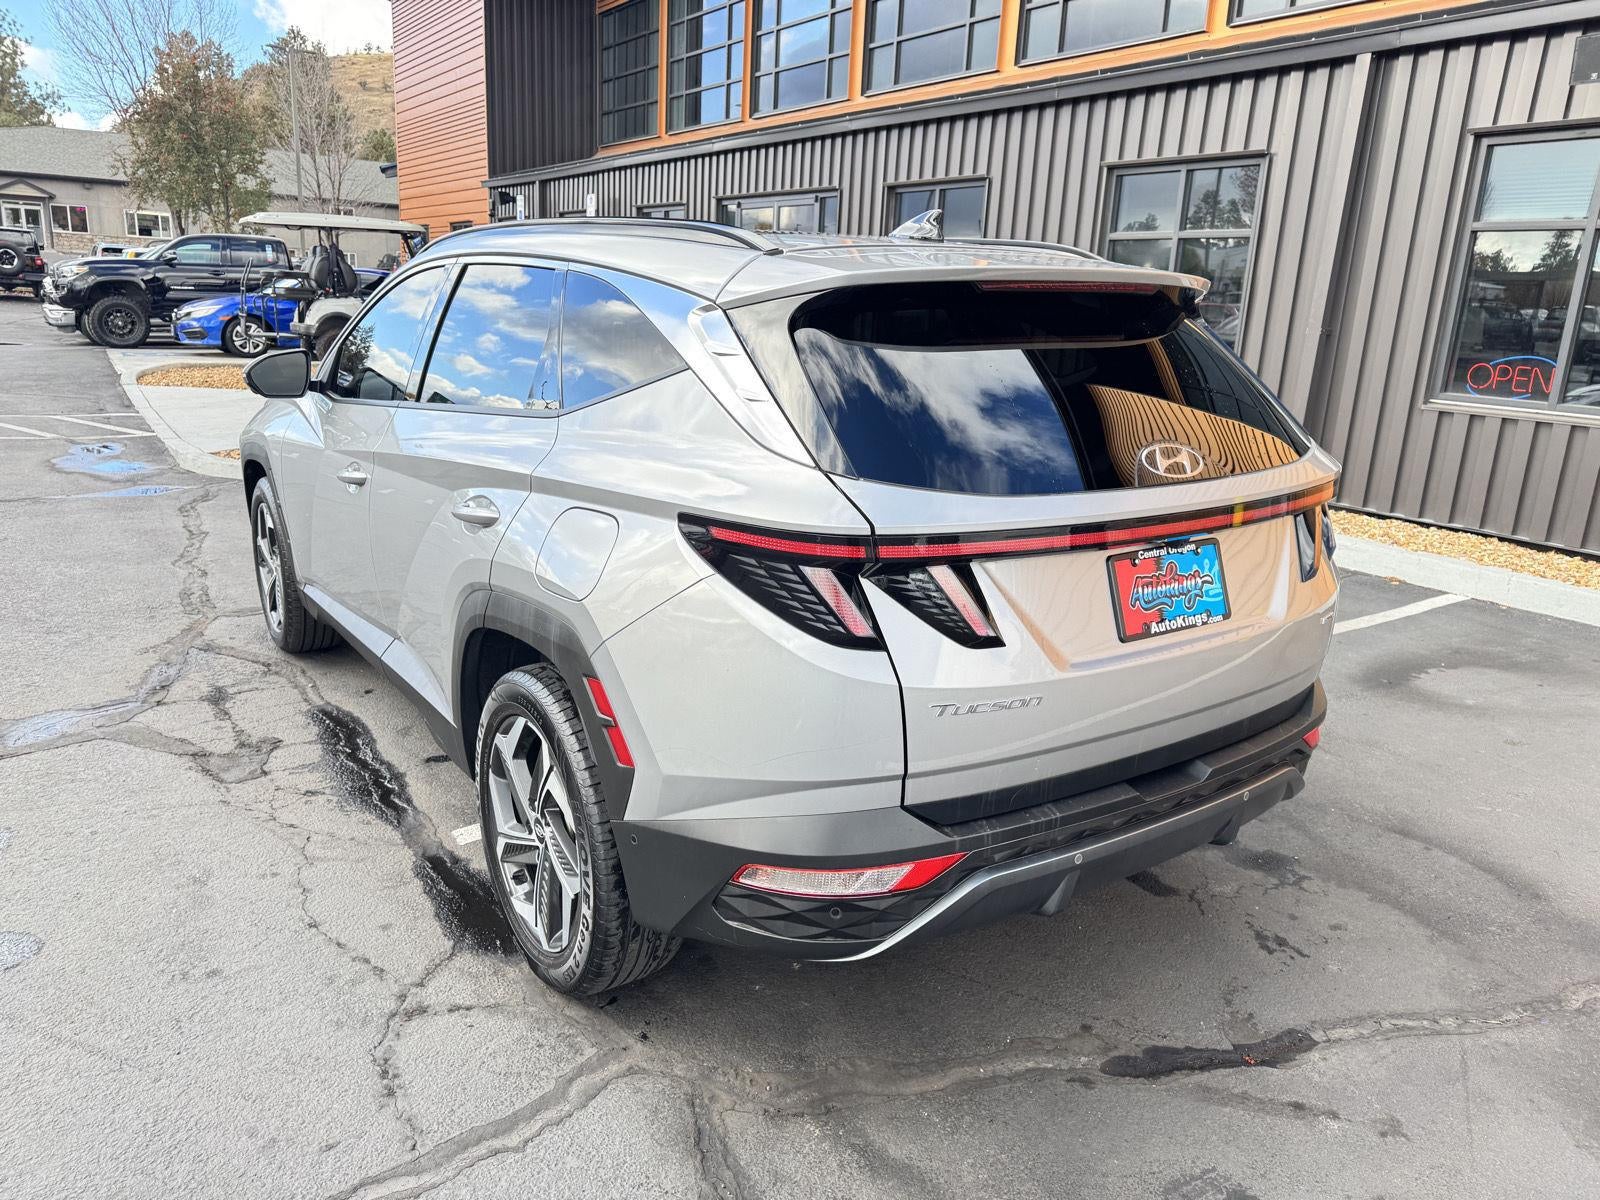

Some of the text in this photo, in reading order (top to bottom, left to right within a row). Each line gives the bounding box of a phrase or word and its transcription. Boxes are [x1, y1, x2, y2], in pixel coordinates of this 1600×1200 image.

[1467, 362, 1556, 394] OPEN
[1138, 547, 1167, 560] Central
[1150, 612, 1223, 634] AutoKings.com
